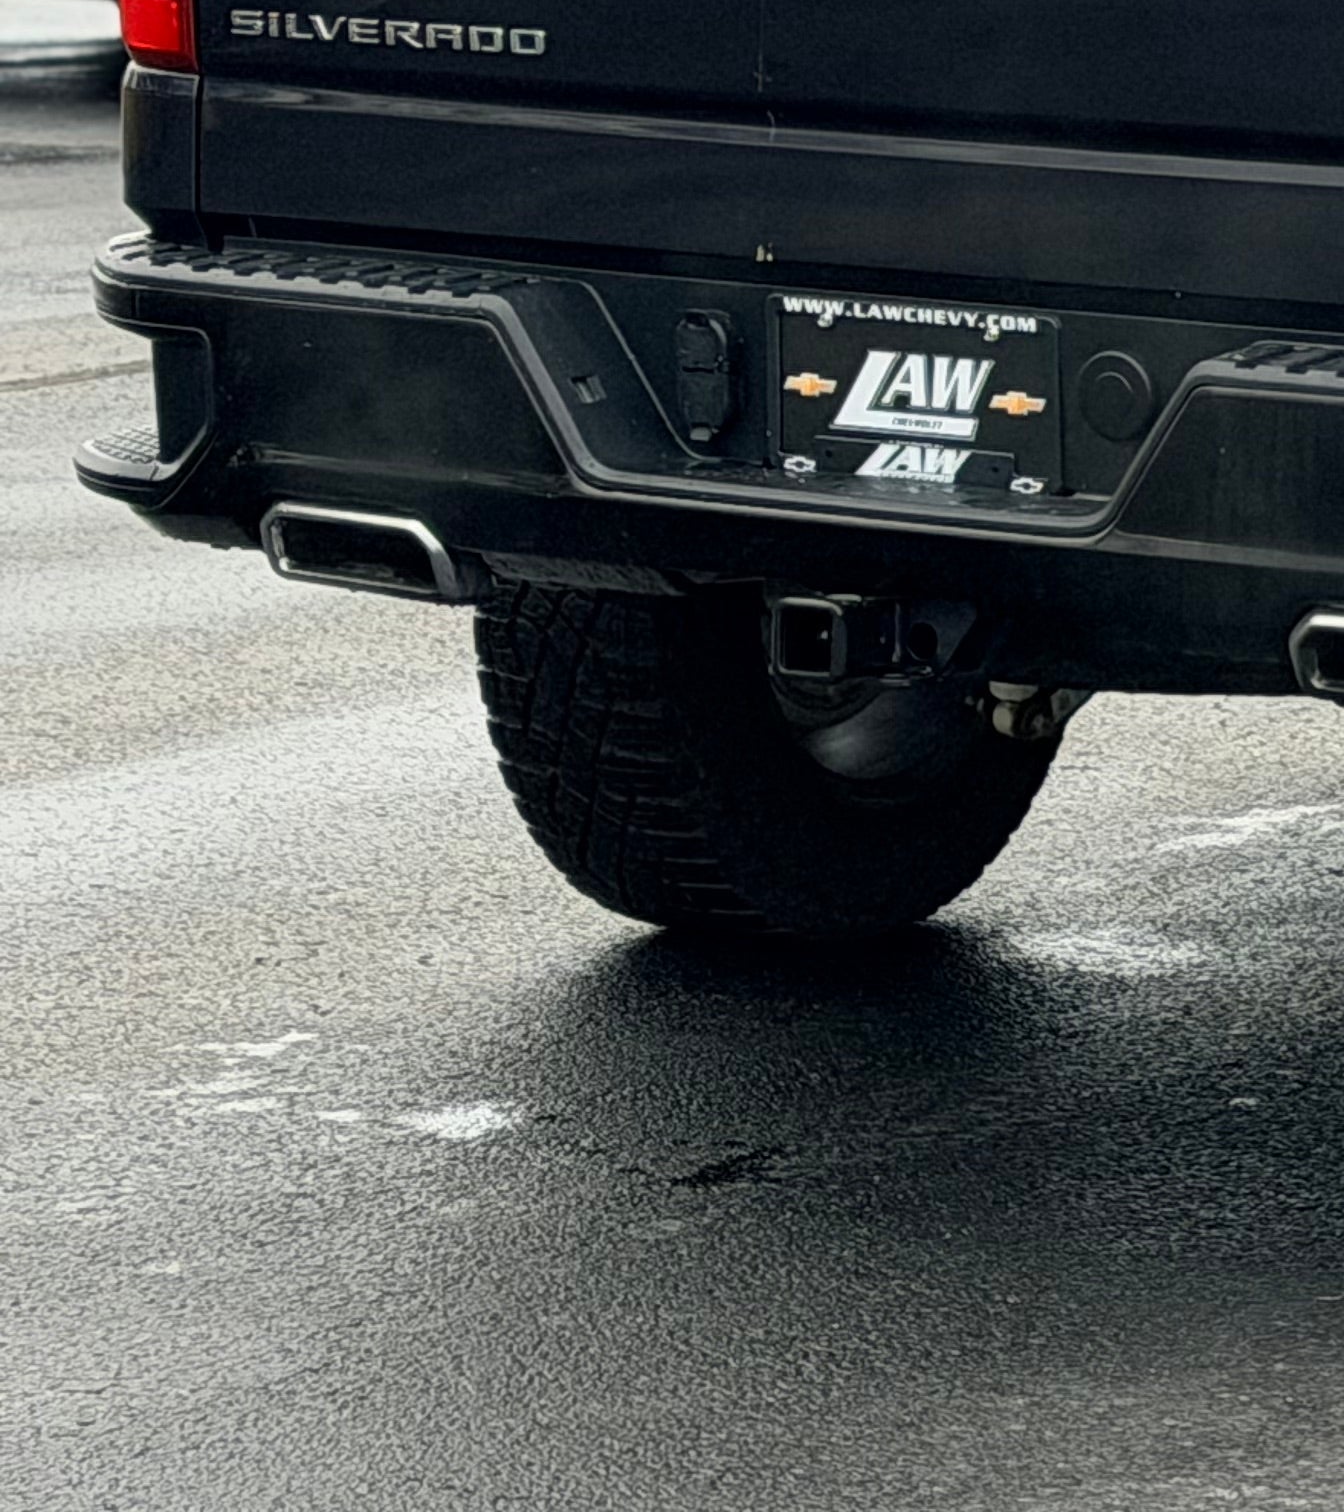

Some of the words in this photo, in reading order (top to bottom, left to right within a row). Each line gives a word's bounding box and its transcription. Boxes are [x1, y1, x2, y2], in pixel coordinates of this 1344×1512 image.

[230, 9, 546, 55] SILVERADO
[783, 296, 1037, 333] WWW.LAWCHEVY.COM
[829, 350, 995, 441] LAW
[854, 443, 973, 484] LAW
